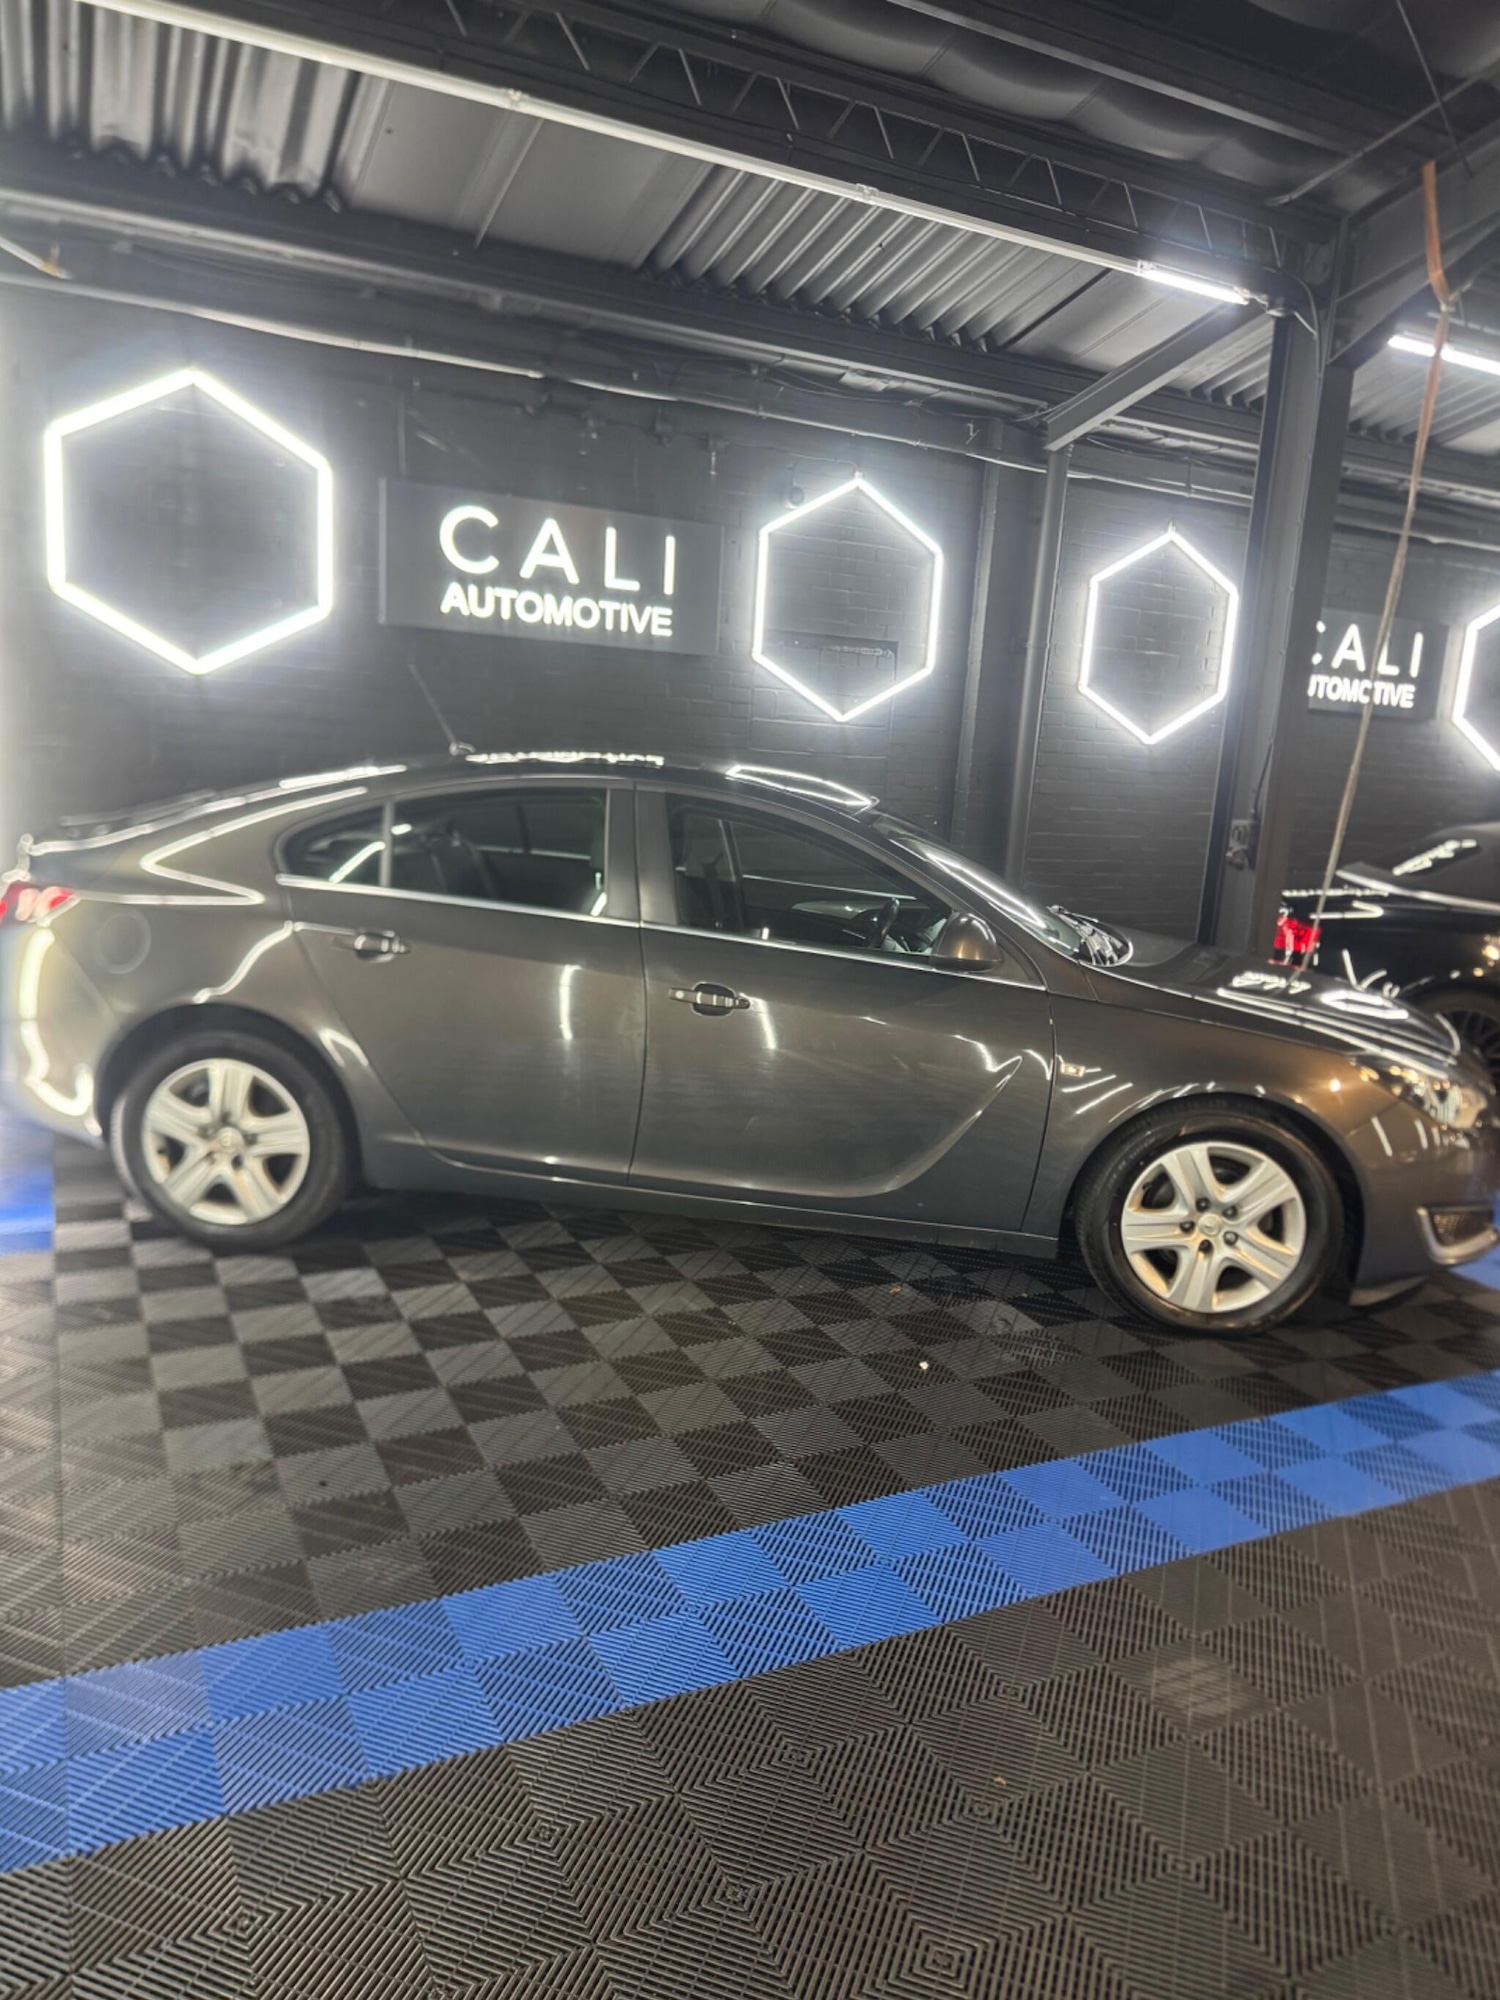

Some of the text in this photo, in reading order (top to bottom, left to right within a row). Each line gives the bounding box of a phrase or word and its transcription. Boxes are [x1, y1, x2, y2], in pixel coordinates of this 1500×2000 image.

[439, 505, 676, 595] CALI
[440, 581, 673, 637] AUTOMOTIVE
[1311, 620, 1424, 678] ALI
[1307, 673, 1416, 709] TOMOTIVE
